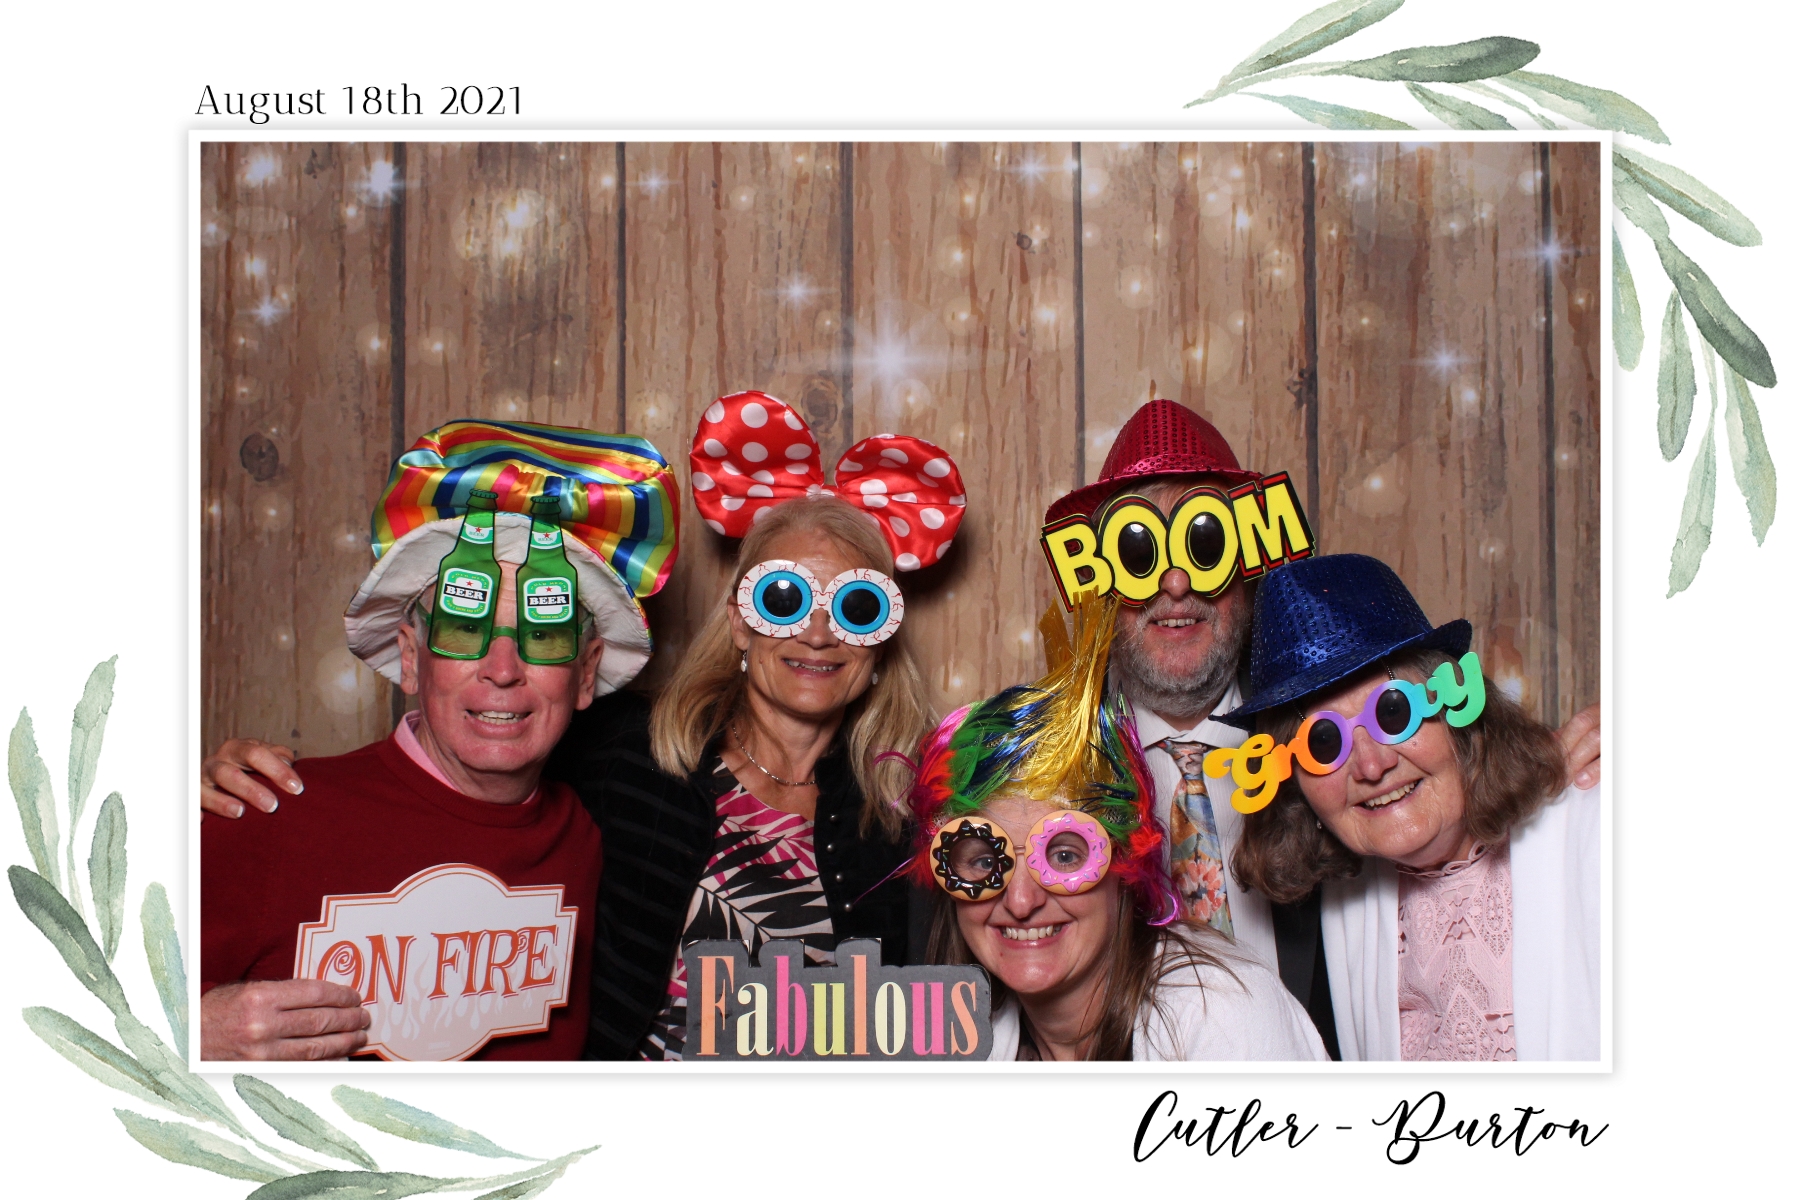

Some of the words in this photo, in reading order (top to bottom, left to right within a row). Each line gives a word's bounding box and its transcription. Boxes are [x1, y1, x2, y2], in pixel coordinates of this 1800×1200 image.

[1041, 472, 1314, 612] BOOM
[445, 585, 484, 601] BEER
[529, 595, 567, 605] BEER
[316, 933, 417, 1006] ON
[427, 924, 559, 999] FIRE
[696, 954, 979, 1056] Fabulous
